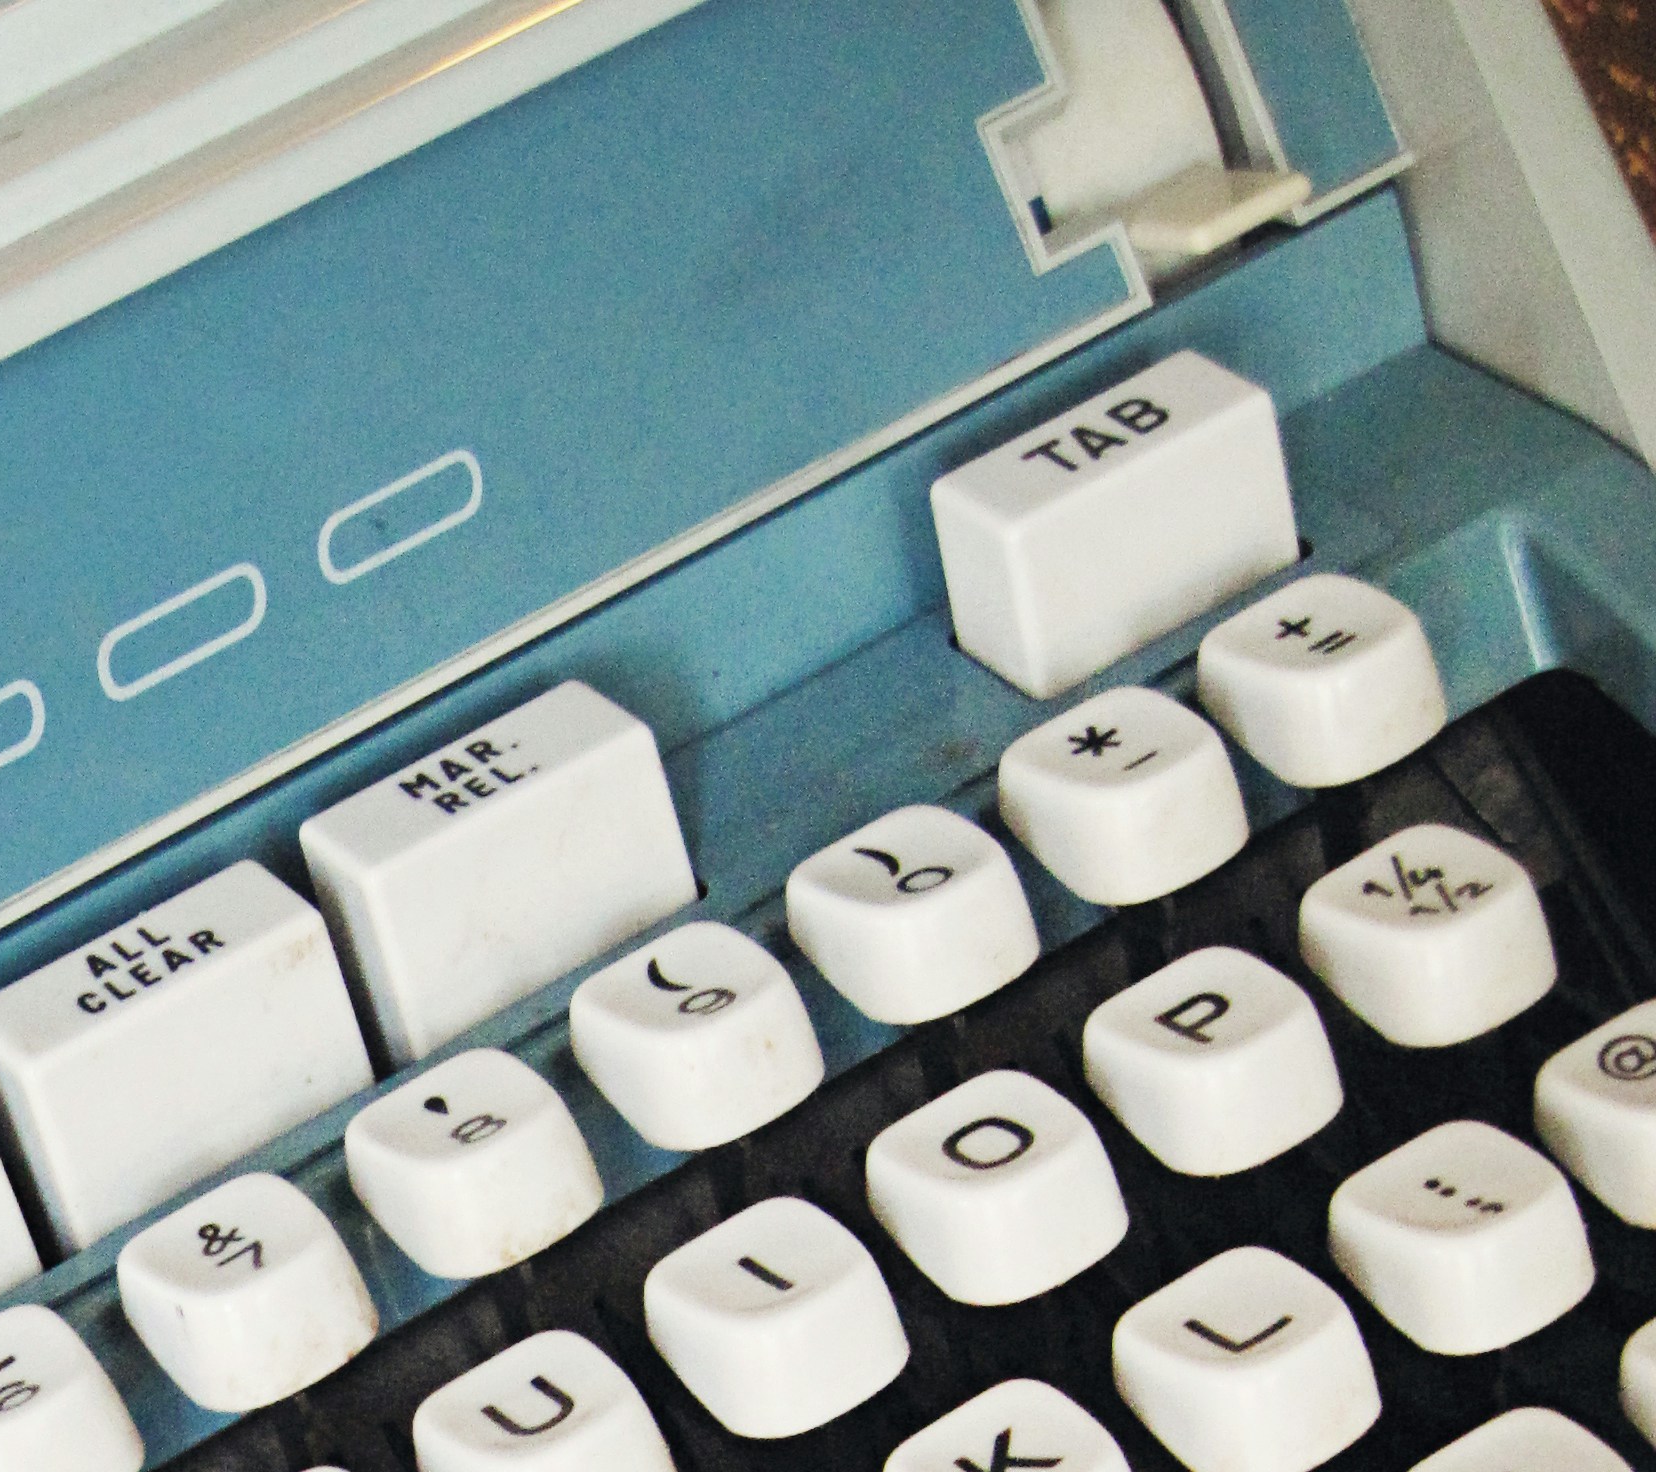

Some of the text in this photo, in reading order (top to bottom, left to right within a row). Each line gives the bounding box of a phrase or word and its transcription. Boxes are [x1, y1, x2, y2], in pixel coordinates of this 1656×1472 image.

[1024, 398, 1171, 473] TAB
[399, 739, 519, 800] MAR.
[432, 759, 538, 815] REL.
[76, 928, 225, 1016] CLEAR
[85, 925, 172, 980] ALL
[1154, 992, 1230, 1044] P
[942, 1116, 1035, 1170] O
[737, 1256, 794, 1291] I
[1183, 1316, 1293, 1354] L
[480, 1375, 575, 1436] U
